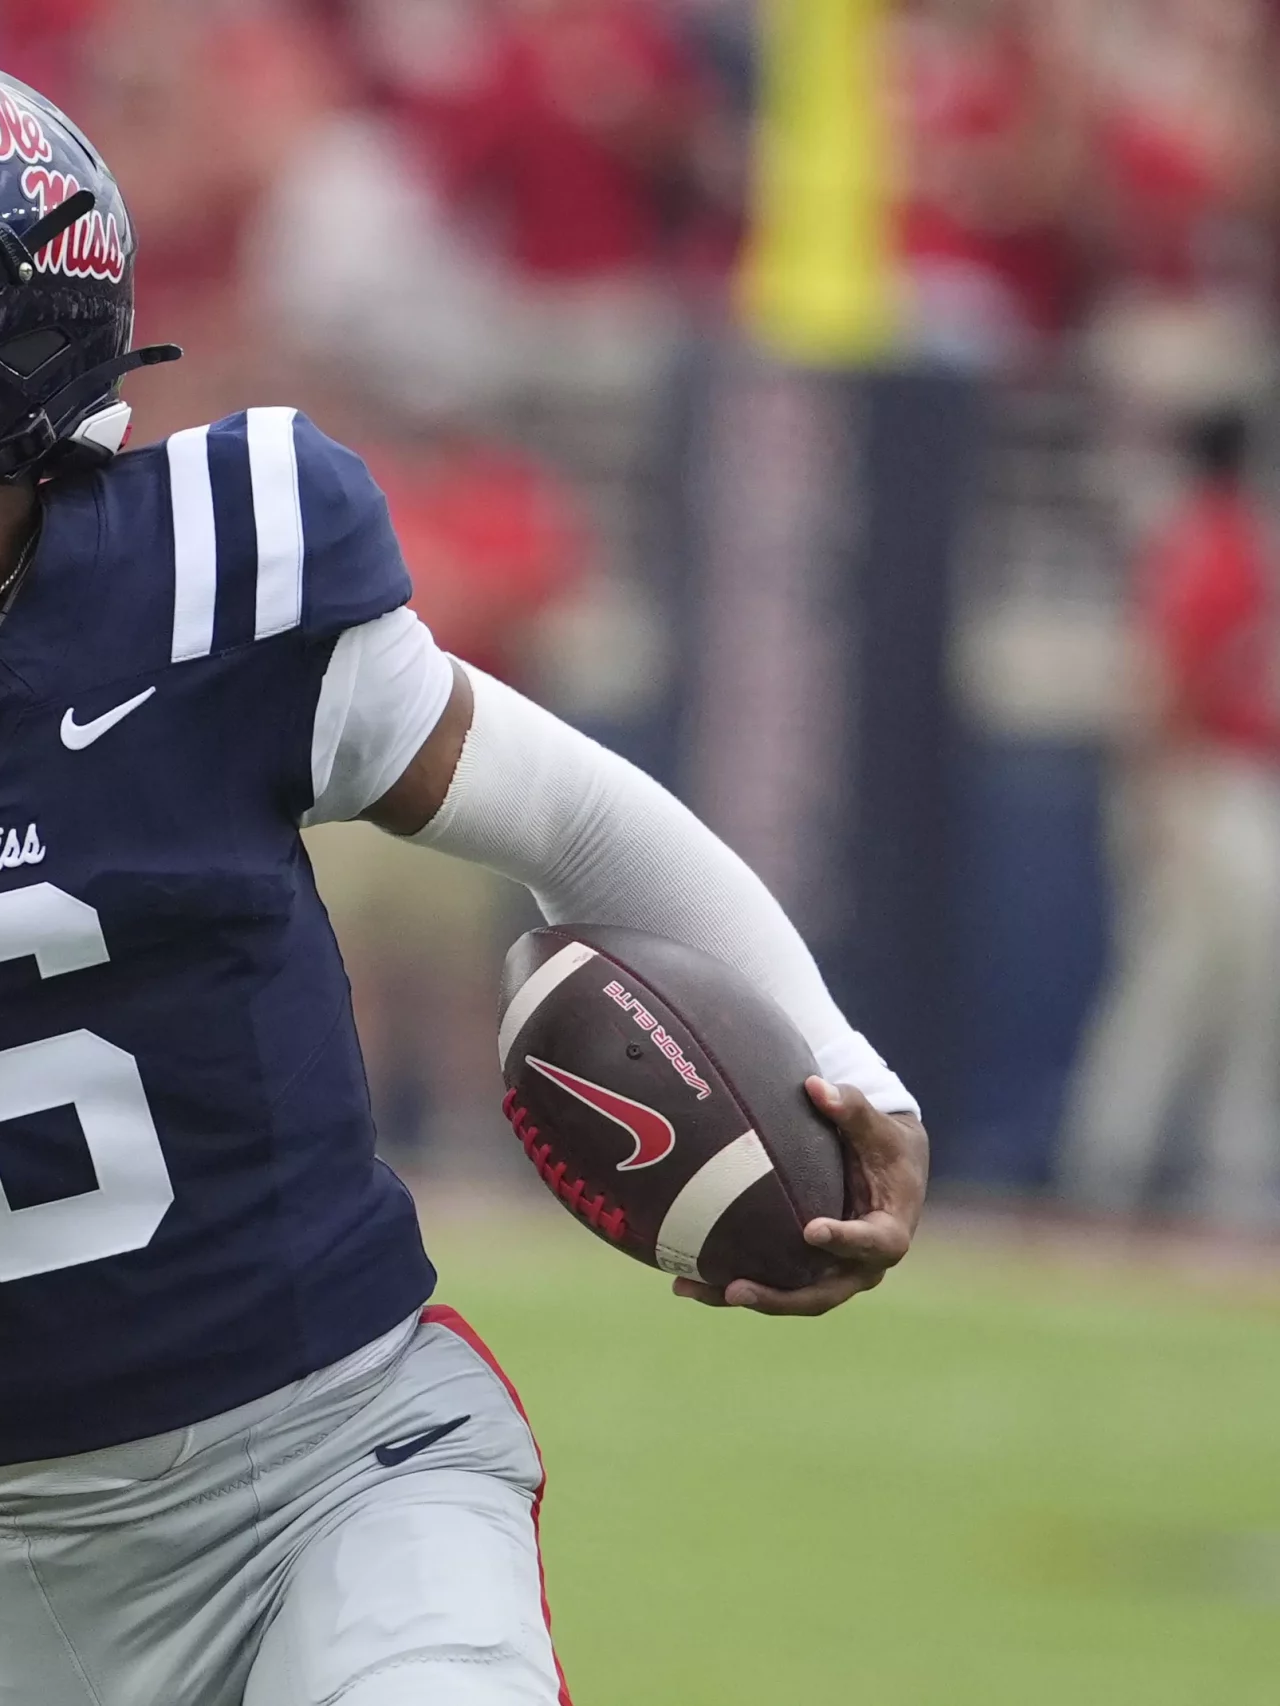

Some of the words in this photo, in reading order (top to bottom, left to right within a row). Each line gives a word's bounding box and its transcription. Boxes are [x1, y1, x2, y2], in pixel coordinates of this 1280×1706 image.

[20, 165, 125, 284] Miss
[602, 979, 659, 1031] ELITE
[650, 1024, 712, 1100] VAPOR
